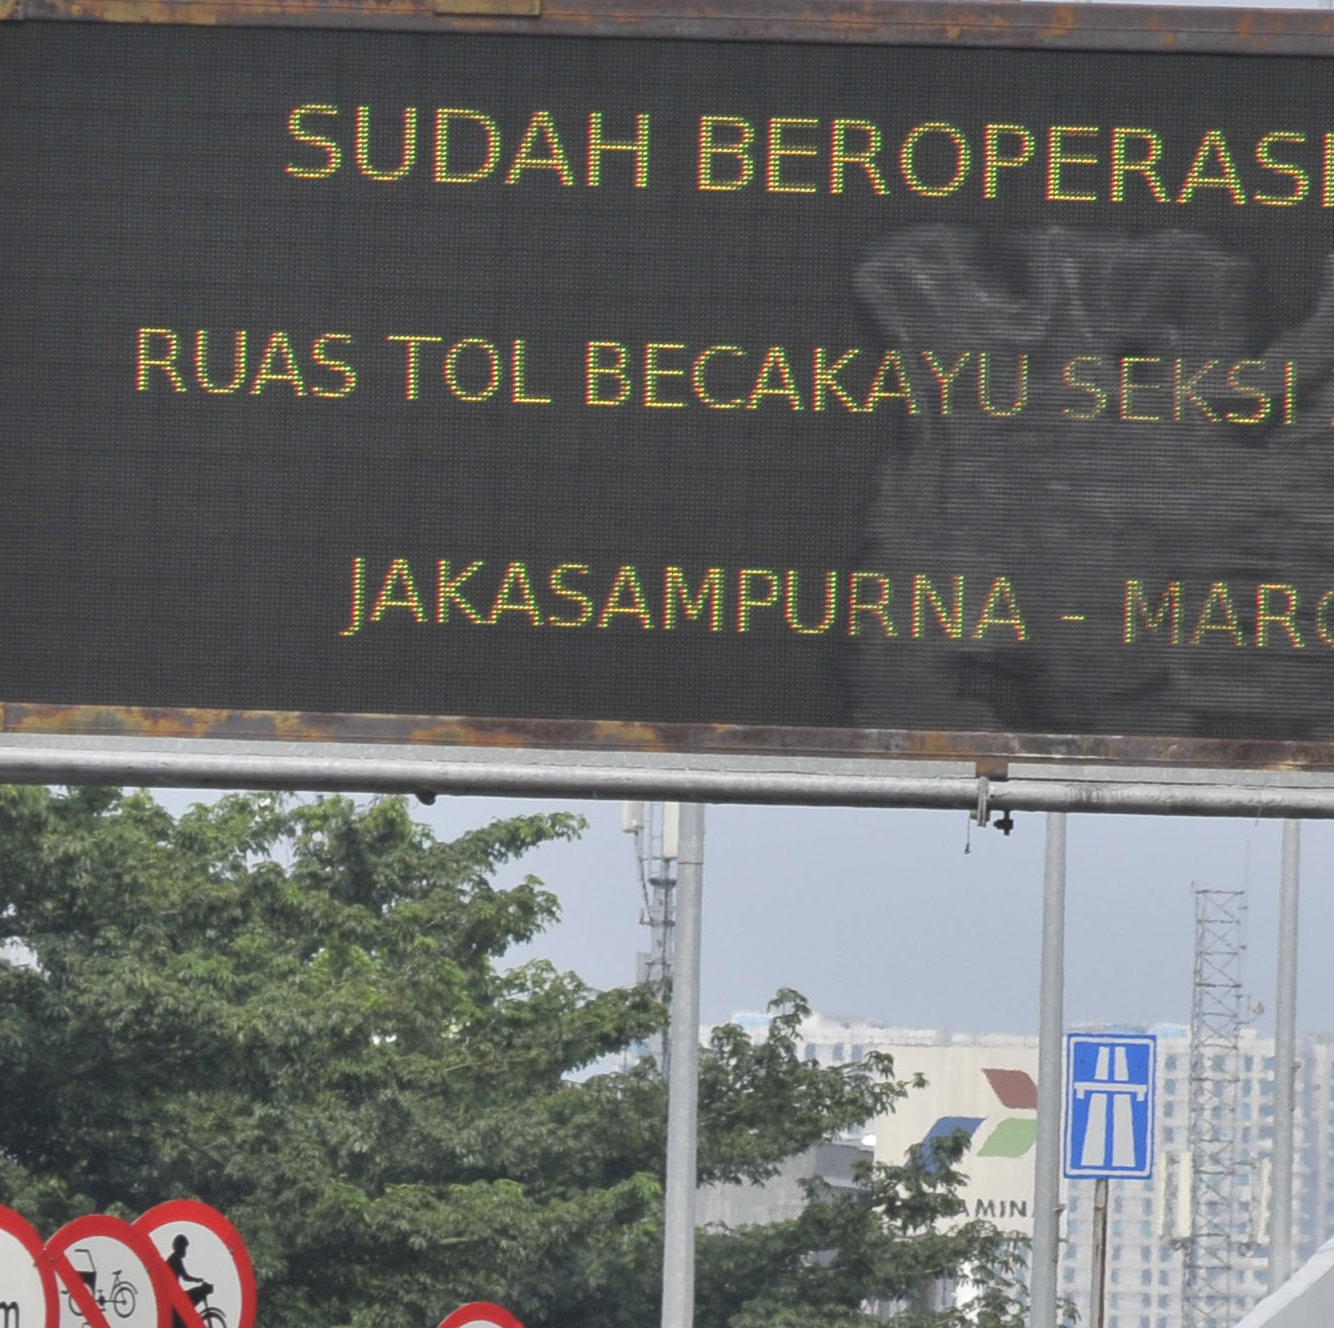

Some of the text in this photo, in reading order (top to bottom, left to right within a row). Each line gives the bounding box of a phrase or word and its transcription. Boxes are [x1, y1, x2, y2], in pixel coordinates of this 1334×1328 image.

[285, 104, 653, 189] SUDAH
[135, 327, 358, 399] RUAS
[388, 335, 552, 405] TOL
[585, 340, 1030, 418] BECAKAYU
[1062, 354, 1299, 426] SEKSI
[340, 557, 1029, 643] JAKASAMPURNA
